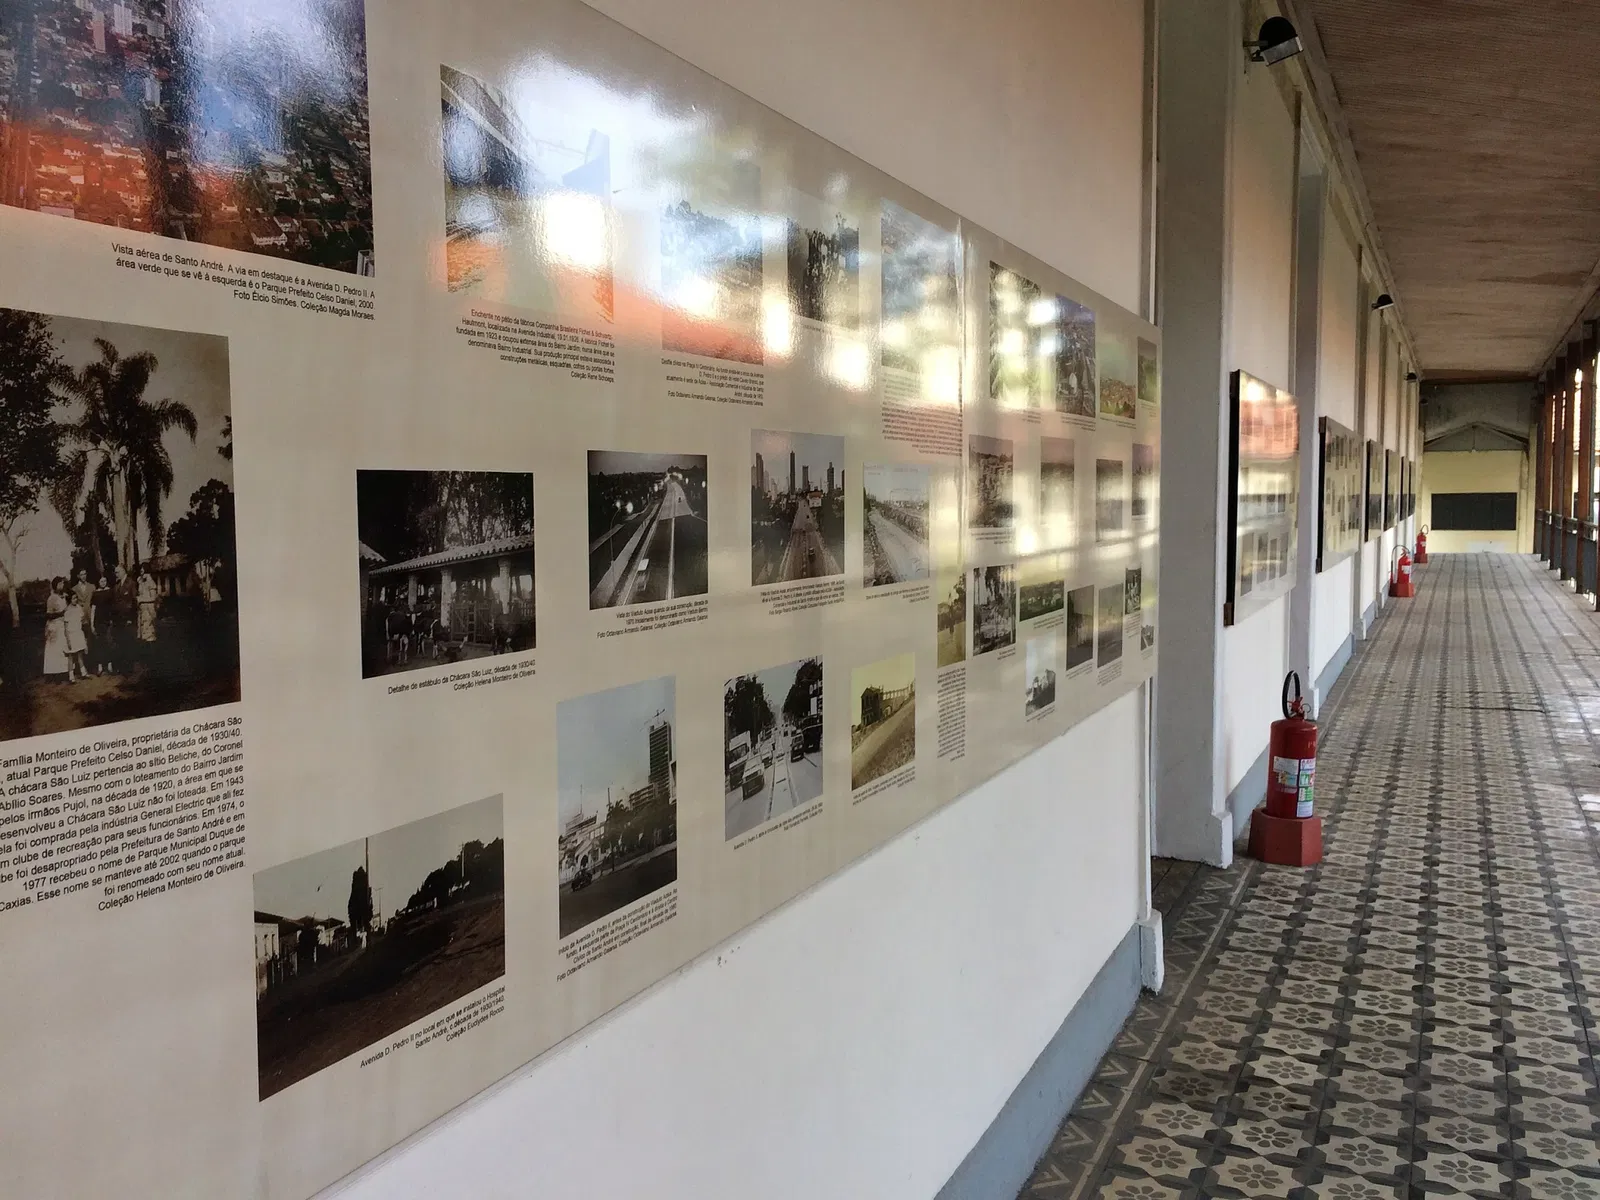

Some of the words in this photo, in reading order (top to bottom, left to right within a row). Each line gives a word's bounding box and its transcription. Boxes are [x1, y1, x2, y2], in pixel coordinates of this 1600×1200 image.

[112, 243, 133, 256] Vista
[136, 247, 160, 260] aérea
[174, 253, 198, 267] Santo
[235, 265, 246, 275] via
[261, 269, 292, 284] destaque
[307, 277, 333, 291] Avenida
[343, 284, 361, 296] Pedro
[116, 256, 135, 269] área
[138, 262, 161, 273] verde
[163, 267, 179, 276] que
[211, 275, 246, 287] esquerda
[261, 281, 286, 294] Parque
[288, 286, 314, 299] Prefeito
[315, 291, 334, 302] Celso
[335, 294, 357, 307] Daniel,
[233, 289, 250, 300] Foto
[252, 290, 269, 303] Élcio
[271, 295, 298, 307] Simões.
[300, 300, 327, 313] Coleção
[328, 305, 350, 316] Magda
[351, 309, 374, 320] Moraes.
[388, 684, 409, 694] Detalhe
[419, 678, 441, 688] estábulo
[449, 673, 470, 682] Chácara
[471, 670, 481, 678] São
[494, 664, 510, 673] década
[453, 680, 474, 691] Coleção
[474, 678, 491, 686] Helena
[492, 674, 512, 683] Monteiro
[519, 669, 535, 677] Oliveira
[6, 768, 30, 782] atual
[33, 763, 67, 777] Parque
[70, 755, 105, 769] Prefeito
[108, 750, 133, 762] Celso
[166, 737, 196, 750] década
[35, 747, 76, 762] Monteiro
[131, 728, 178, 746] proprietária
[193, 720, 225, 733] Chácara
[227, 715, 242, 726] São
[8, 781, 47, 796] chácara
[50, 775, 69, 788] São
[71, 772, 90, 783] Luiz
[93, 763, 133, 781] pertencia
[213, 739, 242, 754] Coronel
[68, 783, 101, 797] Mesmo
[104, 778, 123, 790] com
[133, 766, 178, 783] loteamento
[193, 759, 216, 770] Bairro
[218, 752, 243, 765] Jardim
[27, 806, 60, 820] irmãos
[105, 788, 137, 802] década
[184, 774, 202, 784] área
[218, 767, 232, 778] que
[67, 809, 105, 825] Chácara
[108, 803, 125, 815] São
[127, 799, 145, 811] Luiz
[147, 794, 163, 806] não
[165, 791, 175, 802] foi
[226, 775, 243, 787] 1943
[15, 839, 27, 851] foi
[30, 829, 76, 848] comprada
[79, 823, 98, 838] pela
[101, 814, 138, 830] indústria
[140, 804, 173, 821] General
[175, 797, 204, 812] Electric
[206, 794, 220, 806] que
[222, 790, 231, 800] ali
[232, 788, 243, 798] fez
[12, 852, 38, 866] clube
[56, 835, 102, 855] recreação
[104, 831, 124, 845] para
[126, 825, 146, 837] seus
[16, 867, 28, 879] foi
[30, 851, 97, 876] desapropriado
[100, 845, 118, 860] pela
[121, 834, 162, 852] Prefeitura
[176, 824, 199, 837] Santo
[202, 815, 224, 830] André
[23, 876, 46, 891] 1977
[49, 867, 86, 884] recebeu
[97, 858, 122, 871] nome
[138, 845, 168, 860] Parque
[170, 833, 207, 851] Municipal
[209, 827, 233, 840] Duque
[36, 888, 60, 902] Esse
[63, 880, 88, 894] nome
[104, 865, 141, 882] manteve
[144, 858, 157, 871] até
[159, 852, 179, 867] 2002
[181, 845, 210, 862] quando
[219, 836, 245, 851] parque
[98, 893, 134, 911] Coleção
[136, 884, 165, 900] Helena
[167, 873, 202, 890] Monteiro
[104, 884, 115, 896] foi
[117, 871, 164, 892] renomeado
[166, 866, 184, 878] com
[186, 861, 200, 872] seu
[202, 854, 223, 867] nome
